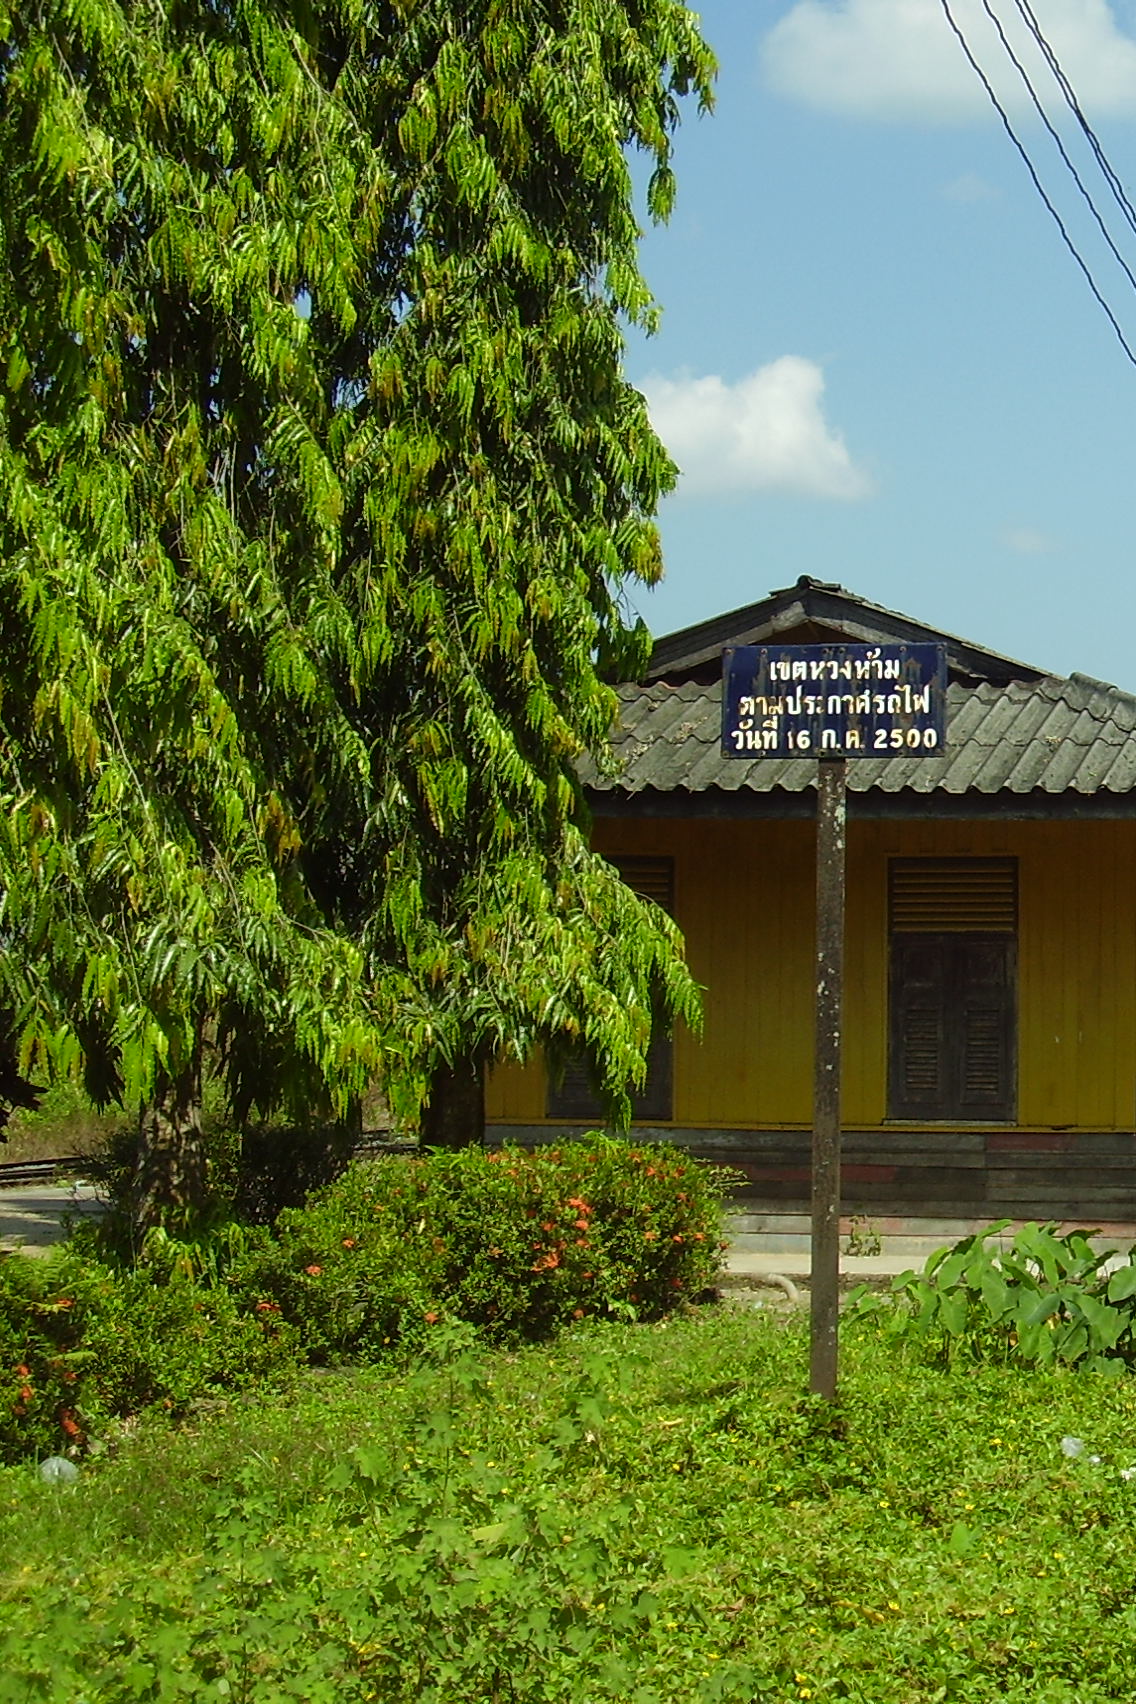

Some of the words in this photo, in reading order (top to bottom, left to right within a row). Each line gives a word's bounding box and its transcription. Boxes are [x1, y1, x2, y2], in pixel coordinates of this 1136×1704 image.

[769, 648, 900, 681] เขตหวงห้าม
[731, 716, 778, 750] วันที่
[787, 729, 812, 749] 16
[873, 728, 938, 749] 2500
